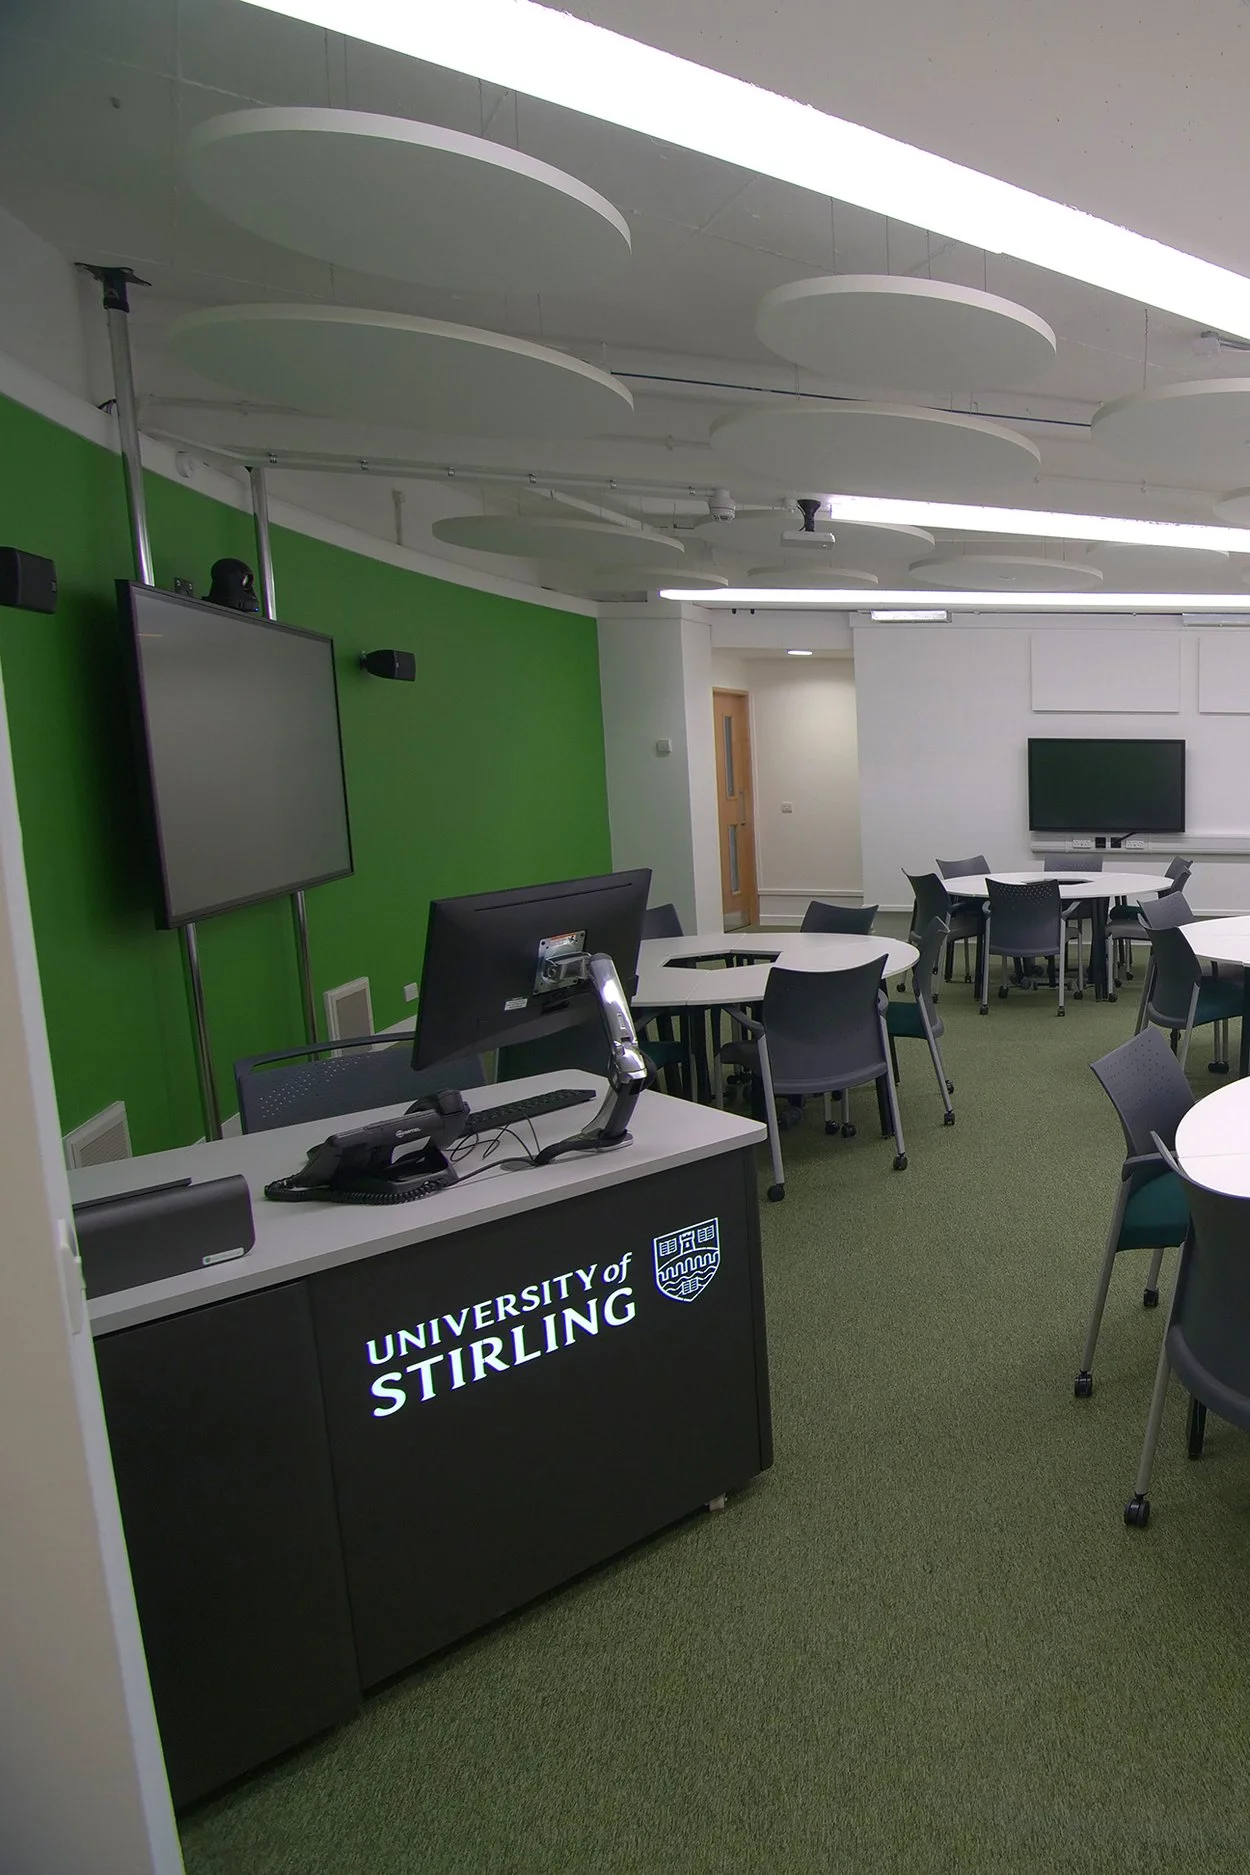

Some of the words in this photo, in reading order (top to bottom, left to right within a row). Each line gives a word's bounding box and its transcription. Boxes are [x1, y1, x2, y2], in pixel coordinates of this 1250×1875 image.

[367, 1264, 597, 1365] UNIVERSITY
[603, 1252, 633, 1284] of
[371, 1287, 636, 1417] STIRLING
